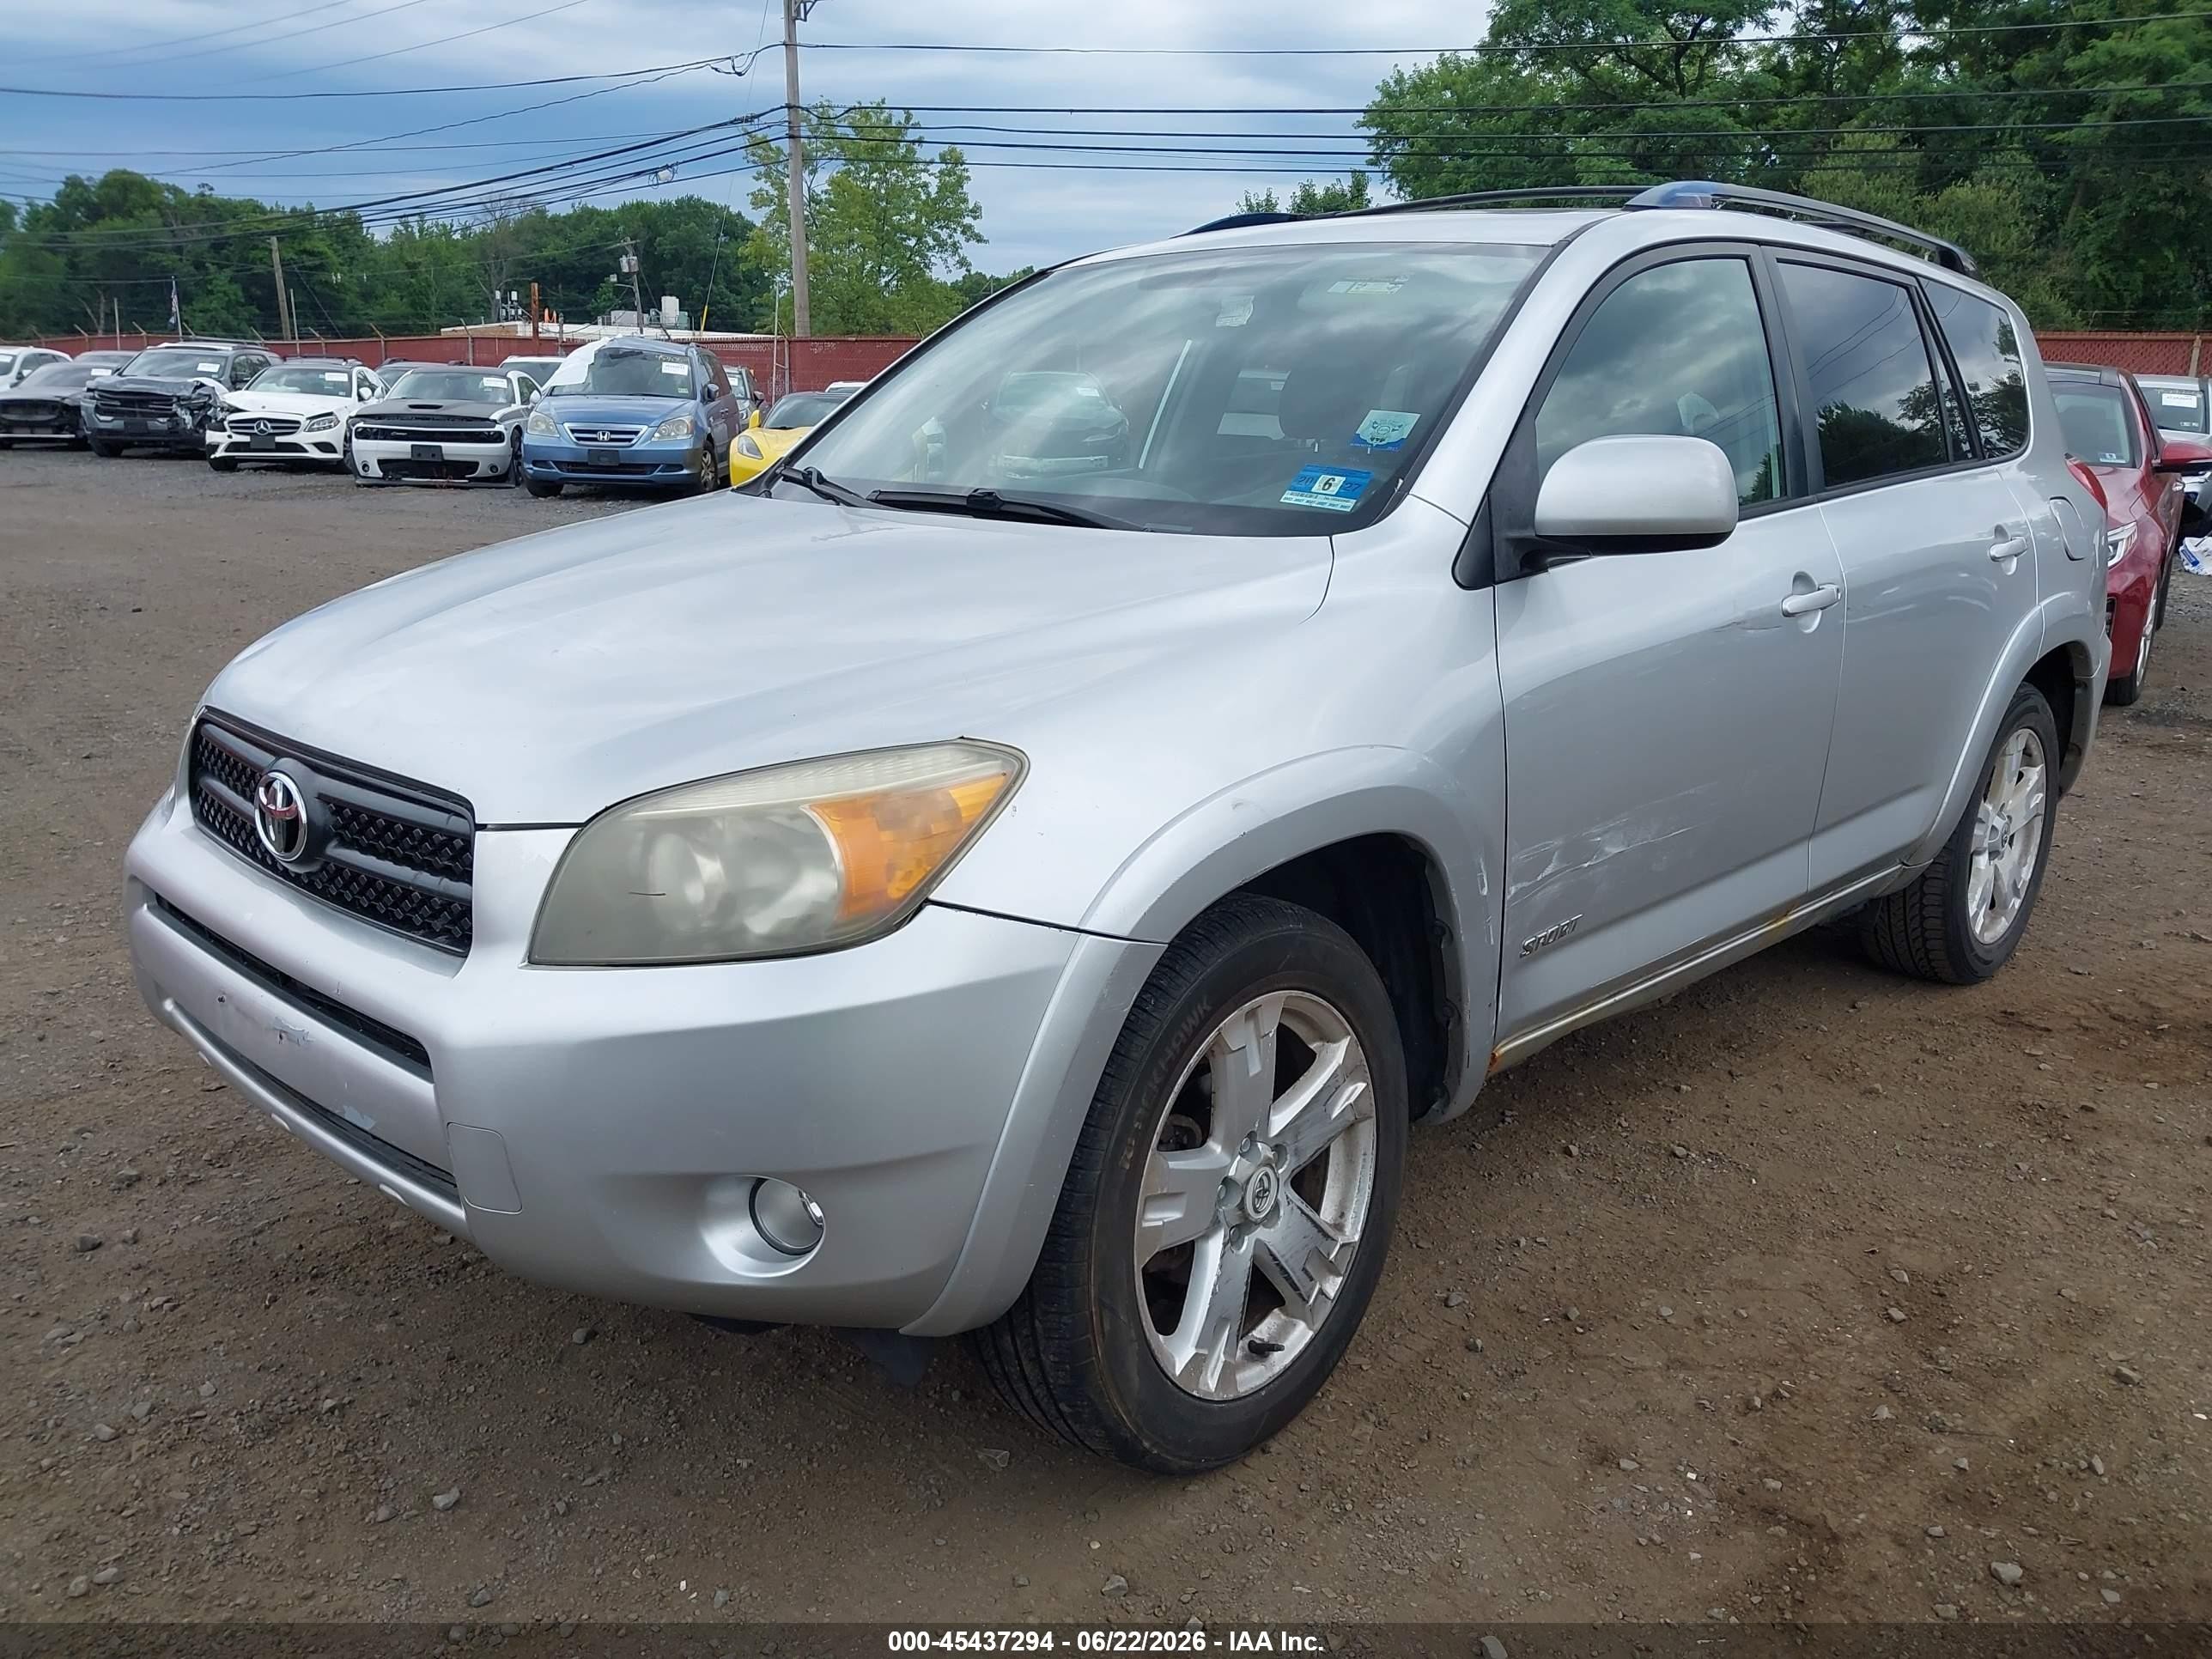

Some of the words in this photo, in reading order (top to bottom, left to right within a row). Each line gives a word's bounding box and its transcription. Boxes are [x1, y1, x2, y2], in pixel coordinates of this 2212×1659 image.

[1322, 477, 1335, 491] 6
[1344, 483, 1361, 492] 27
[1519, 914, 1583, 958] SPORT
